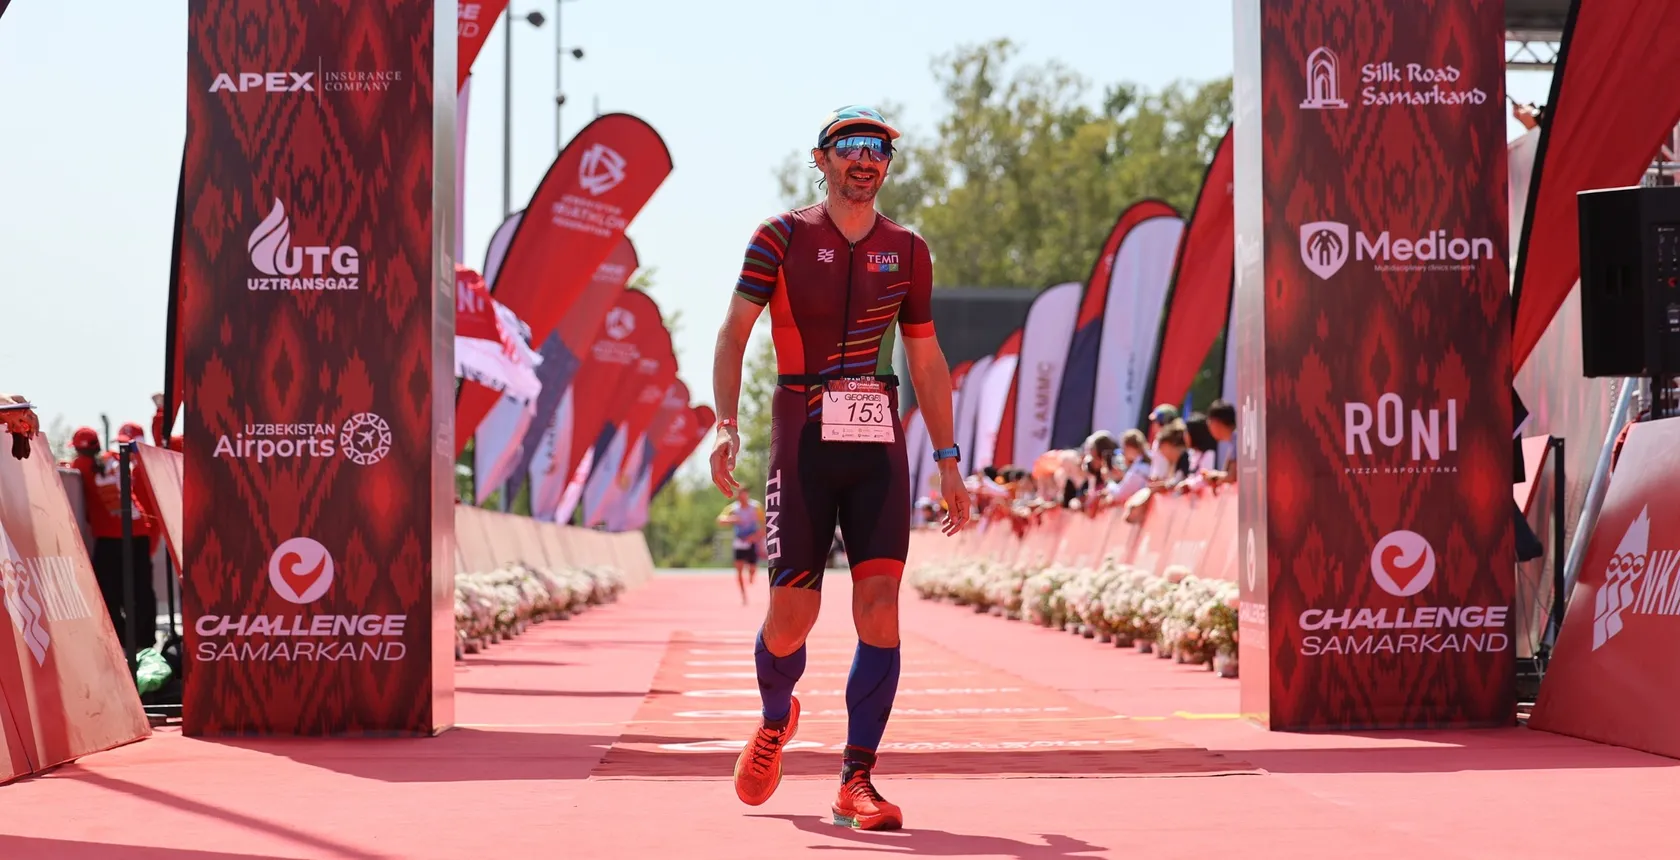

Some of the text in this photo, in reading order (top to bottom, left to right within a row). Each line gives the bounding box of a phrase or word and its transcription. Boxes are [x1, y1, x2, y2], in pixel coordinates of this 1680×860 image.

[209, 72, 314, 92] APEX
[325, 71, 401, 81] INSURANCE
[1361, 62, 1461, 83] Silk Road
[325, 81, 390, 91] COMPANY
[1362, 85, 1487, 106] Samarkand
[1355, 230, 1493, 261] Medion
[276, 245, 359, 275] UTG
[1427, 264, 1448, 272] clinics
[1449, 264, 1476, 272] network
[247, 278, 359, 291] UZTRANSGAZ
[847, 402, 884, 423] 153
[245, 423, 336, 436] UZBEKISTAN
[1345, 392, 1457, 461] RONI
[213, 434, 335, 463] Airports
[1384, 466, 1458, 474] NAPOLETANA
[195, 614, 407, 637] CHALLENGE
[1299, 606, 1509, 631] CHALLENGE
[195, 641, 407, 662] SAMARKAND
[1300, 633, 1509, 656] SAMARKAND
